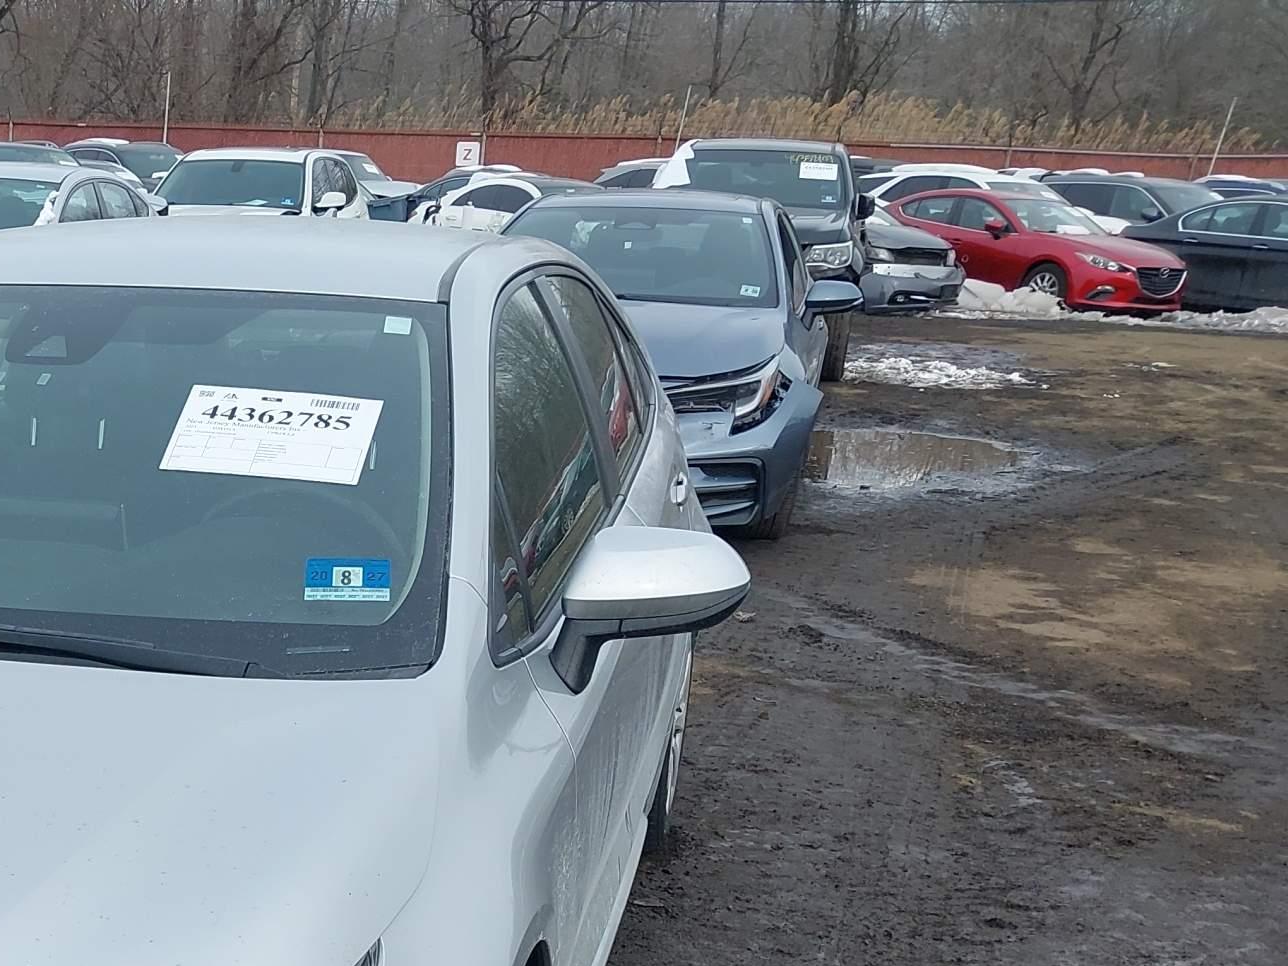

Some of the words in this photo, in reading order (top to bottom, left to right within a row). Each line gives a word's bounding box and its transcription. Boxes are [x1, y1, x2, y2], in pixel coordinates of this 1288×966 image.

[463, 148, 473, 161] Z
[201, 404, 353, 431] 44362785
[311, 570, 328, 581] 20
[340, 569, 352, 586] 8
[367, 571, 386, 582] 27
